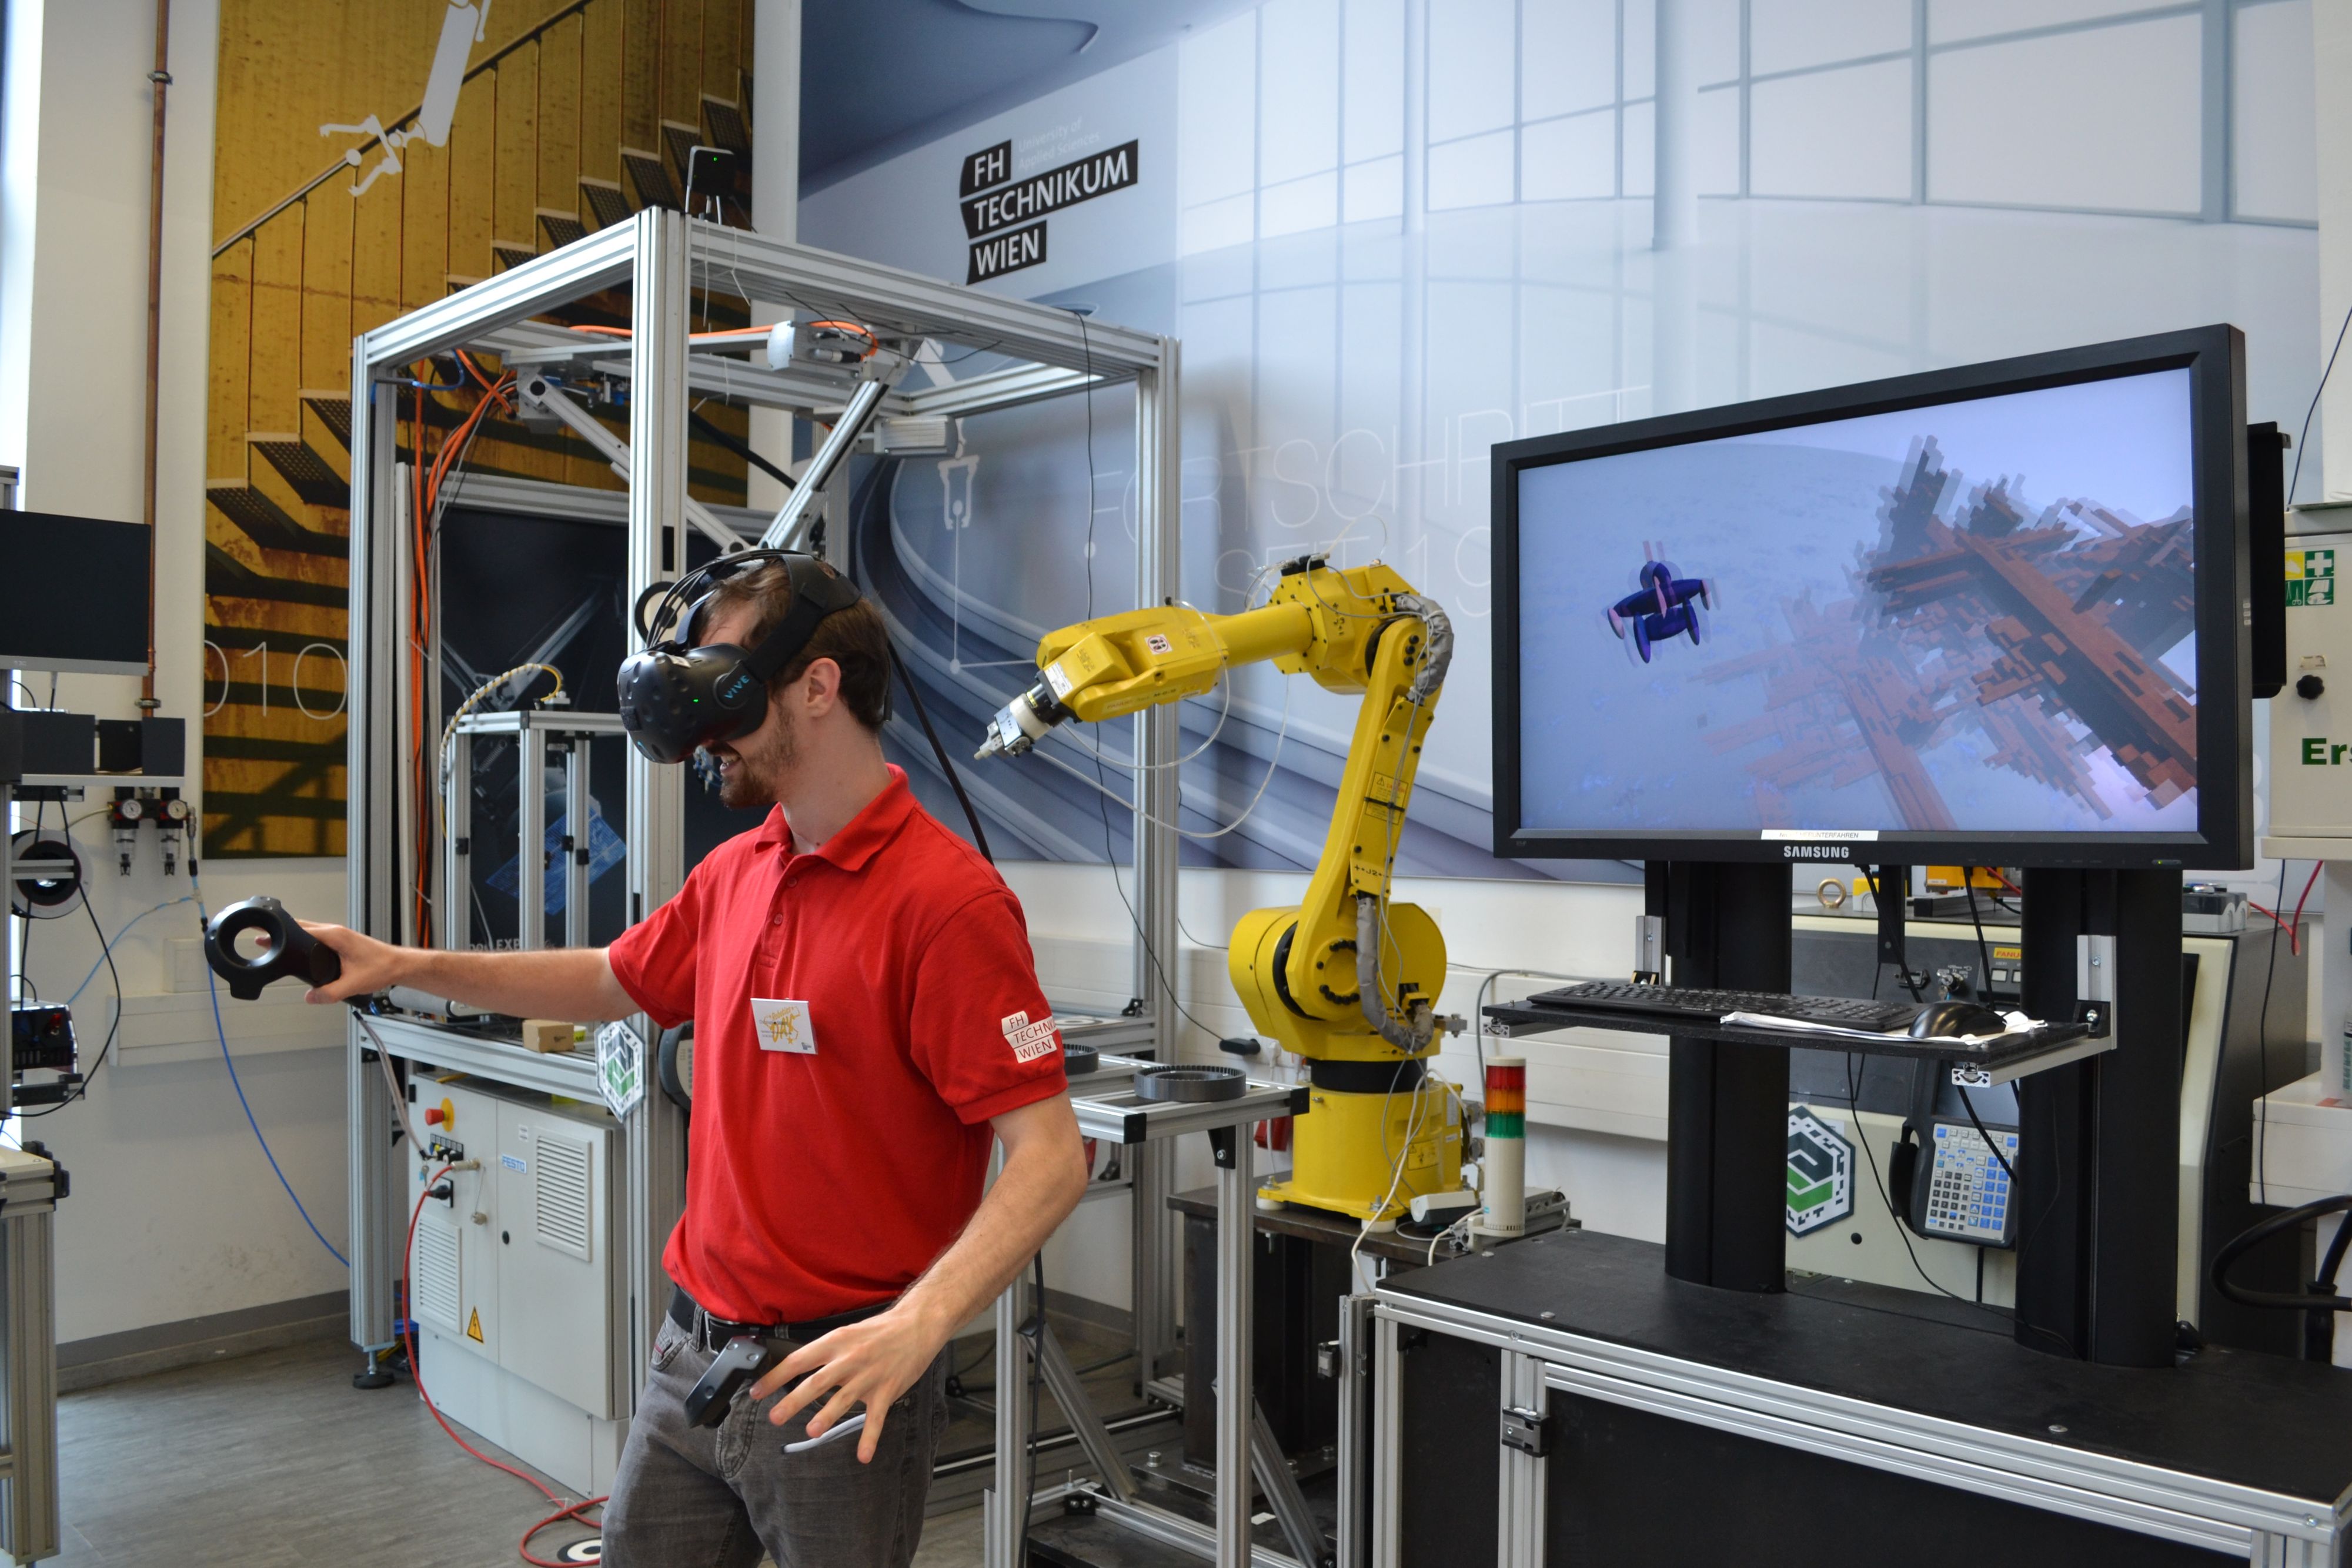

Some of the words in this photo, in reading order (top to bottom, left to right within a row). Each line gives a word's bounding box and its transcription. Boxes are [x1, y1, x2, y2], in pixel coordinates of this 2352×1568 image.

[1018, 125, 1069, 153] University
[1071, 116, 1083, 132] of
[1018, 145, 1055, 171] Applied
[1057, 131, 1101, 156] Sciences
[974, 148, 1004, 188] FH
[974, 149, 1129, 231] TECHNIKUM
[975, 228, 1040, 276] WIEN
[724, 674, 750, 700] VIVE
[1783, 845, 1849, 859] SAMSUNG
[1007, 1012, 1023, 1027] FH
[1017, 1035, 1048, 1054] WIEN
[502, 1155, 525, 1173] FESTO
